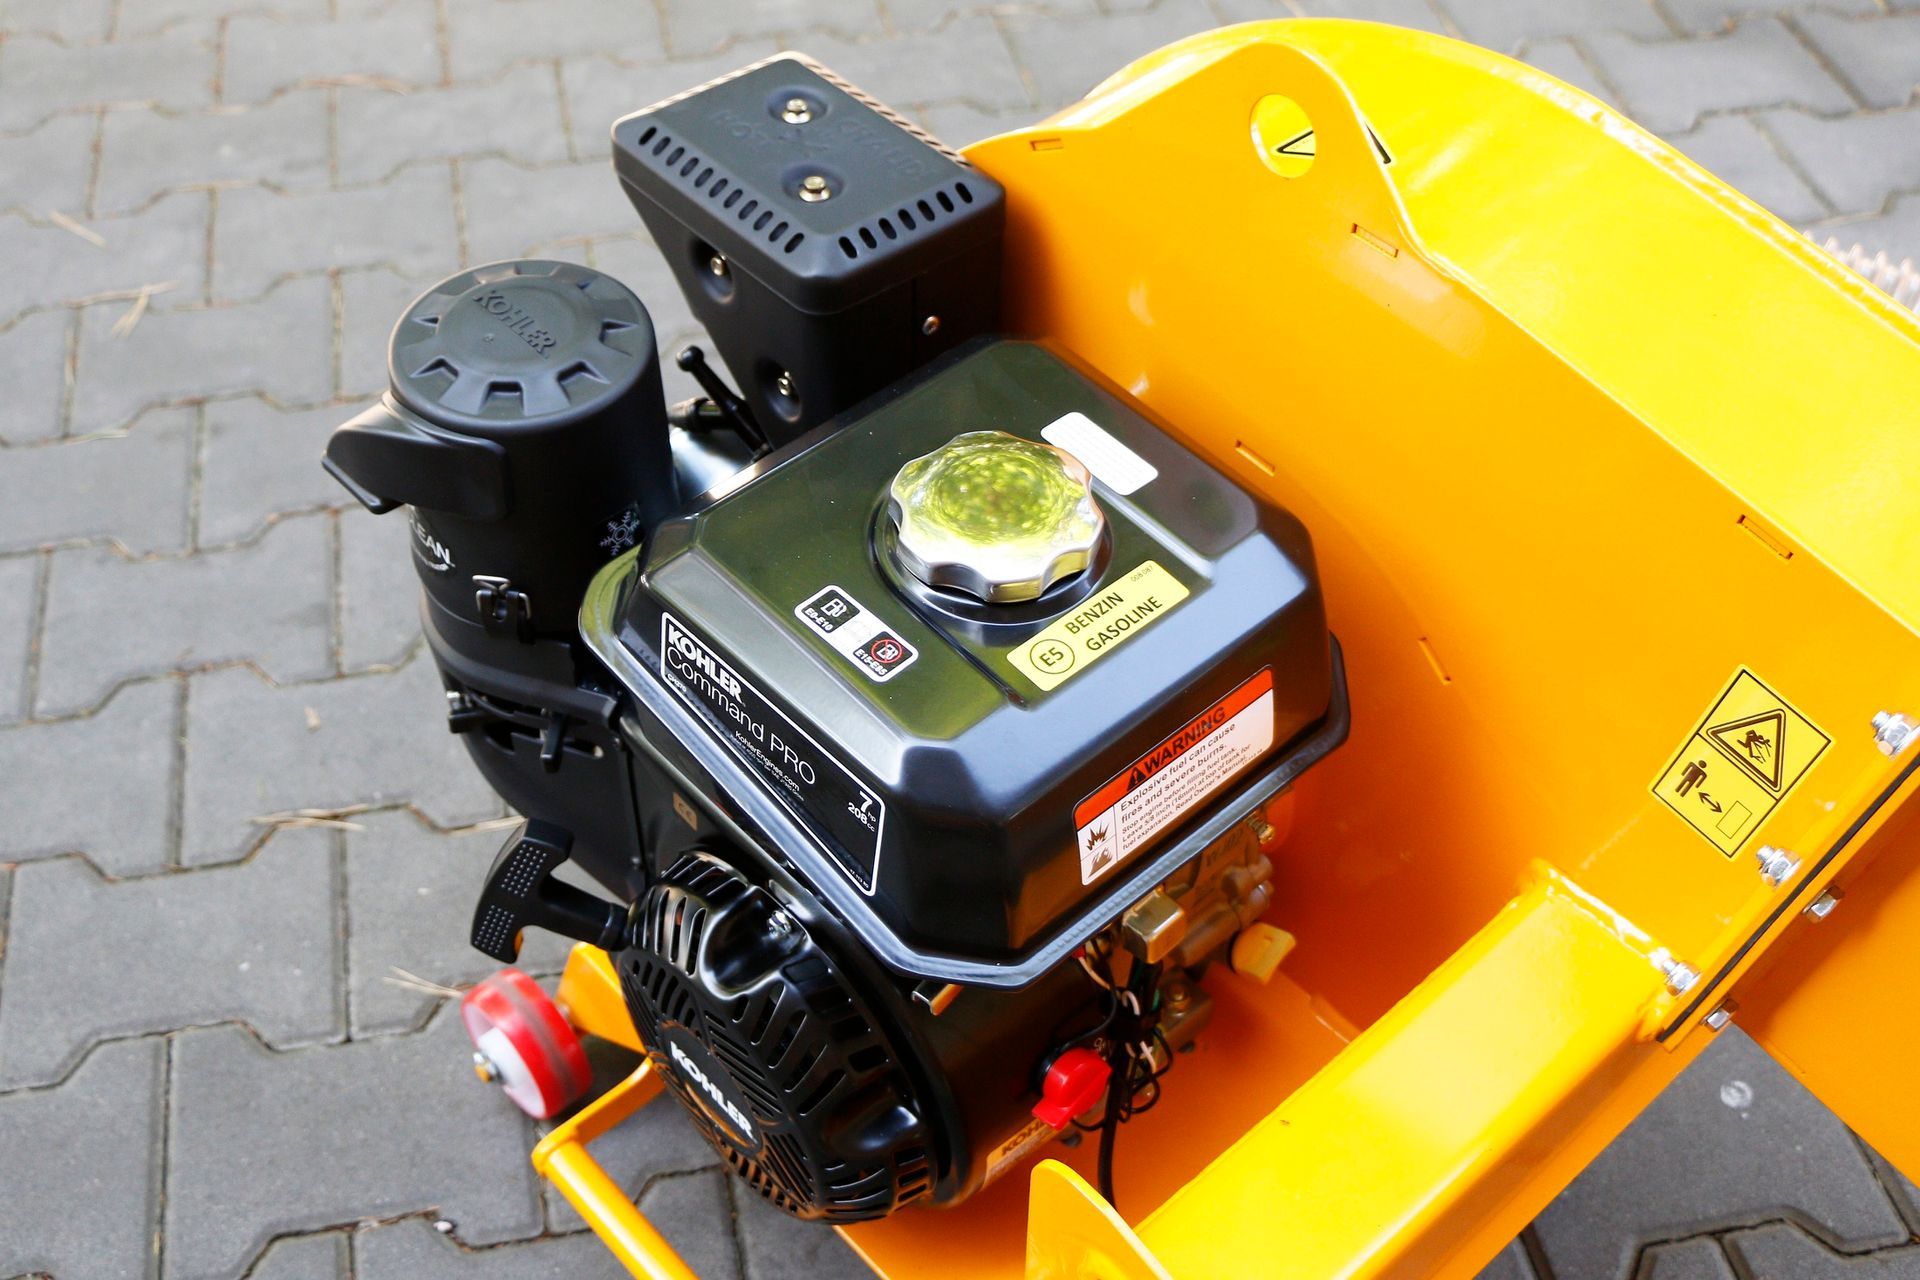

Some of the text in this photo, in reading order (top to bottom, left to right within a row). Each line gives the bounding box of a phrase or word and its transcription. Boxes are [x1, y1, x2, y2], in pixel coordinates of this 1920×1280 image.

[472, 289, 556, 353] KOHLER
[804, 607, 834, 632] E0-E10
[1064, 591, 1124, 635] BENZIN
[1086, 596, 1163, 652] GASOLINE
[667, 622, 743, 703] KOHLER
[854, 648, 888, 676] E15-E85
[1039, 647, 1064, 667] E5
[666, 645, 765, 743] Command
[770, 732, 817, 786] PRO
[1143, 705, 1226, 774] WARNING
[735, 730, 801, 792] KohlerEngines.com
[1120, 722, 1236, 812] Explosive fuel can cause
[1121, 803, 1143, 824] fires
[1144, 787, 1163, 806] and
[1164, 765, 1195, 791] severe
[1197, 743, 1227, 769] burns.
[1121, 819, 1139, 836] Stop
[1141, 801, 1163, 822] engine
[1163, 784, 1186, 803] before
[1186, 769, 1206, 789] filling
[1207, 756, 1221, 772] fuel
[1122, 823, 1143, 842] Leave
[1155, 802, 1171, 819] inch
[1122, 835, 1138, 851] fuel
[1175, 795, 1194, 813] Read
[669, 1040, 758, 1144] KOHLER
